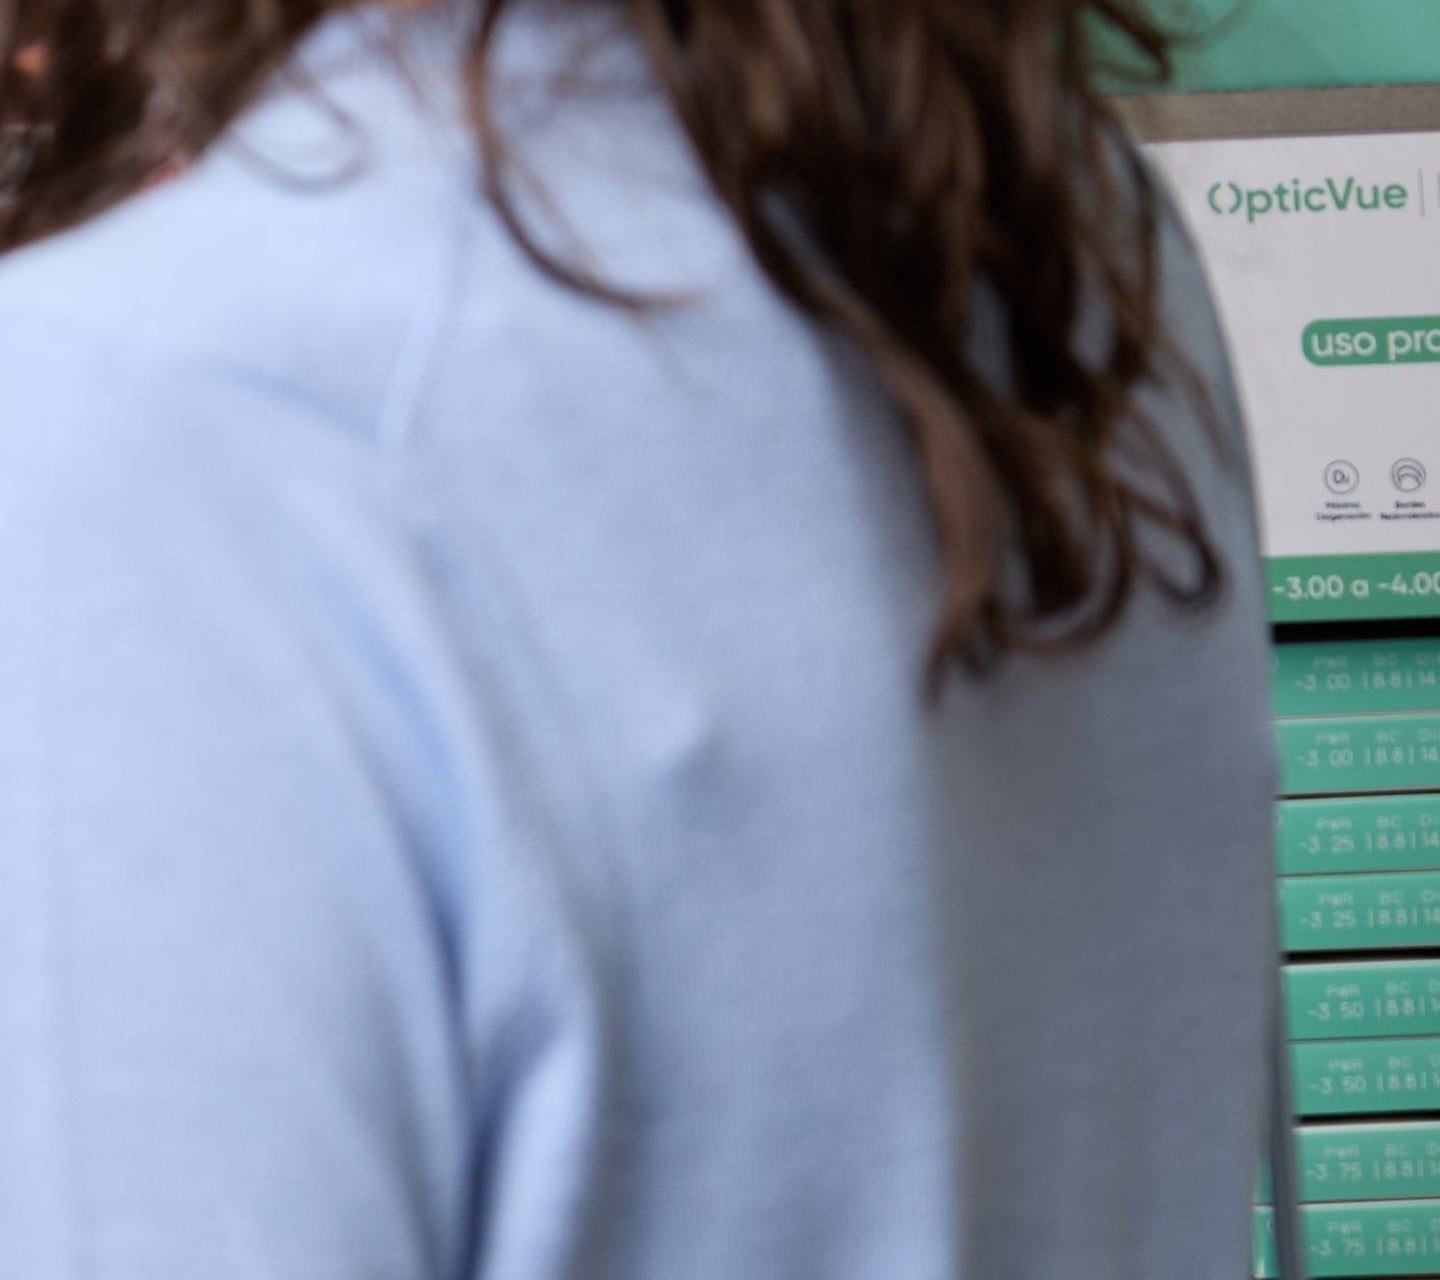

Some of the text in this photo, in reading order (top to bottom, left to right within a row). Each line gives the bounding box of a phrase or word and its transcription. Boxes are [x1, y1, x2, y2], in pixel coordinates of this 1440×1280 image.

[1207, 176, 1409, 223] OpticVue
[1310, 329, 1378, 359] uso
[1271, 574, 1345, 600] -3.00
[1349, 578, 1371, 598] a
